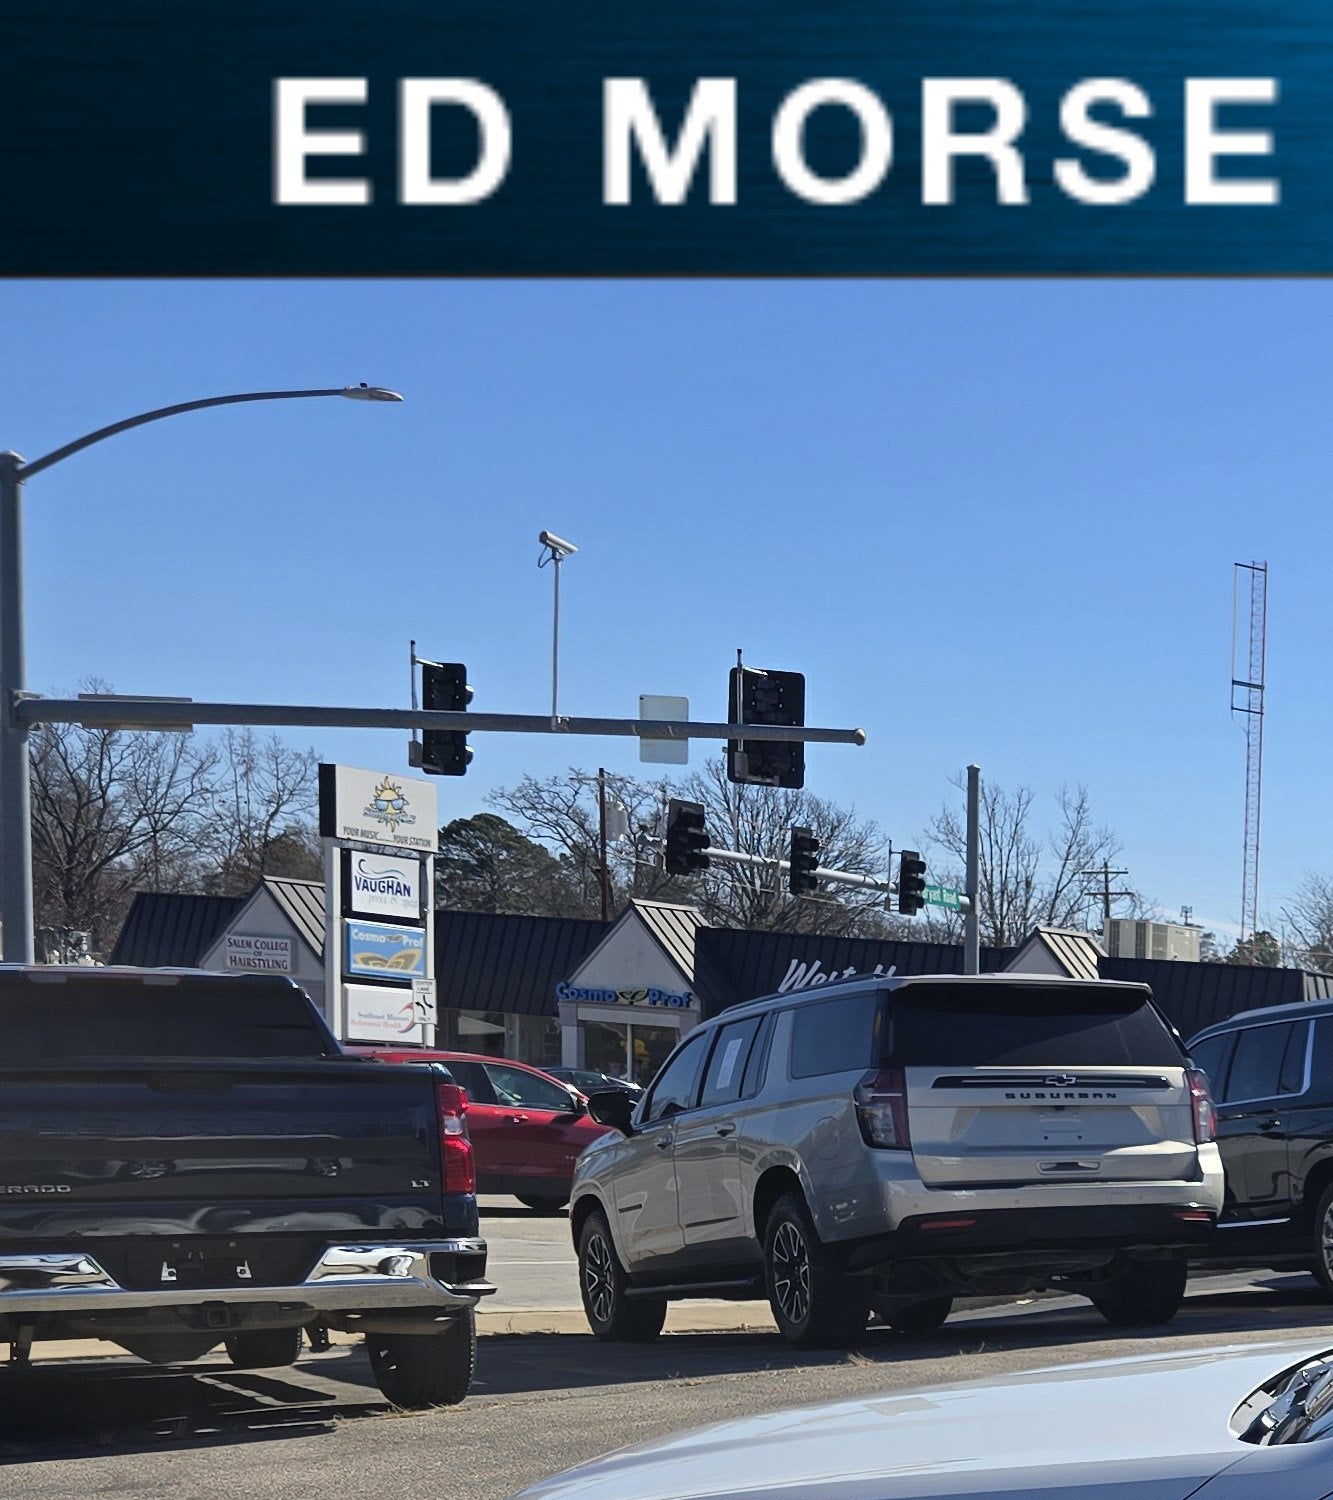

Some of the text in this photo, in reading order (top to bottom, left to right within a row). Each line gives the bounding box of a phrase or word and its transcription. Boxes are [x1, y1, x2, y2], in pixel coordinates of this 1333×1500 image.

[354, 875, 412, 897] VAUGHAN
[227, 937, 289, 951] SALEM COLLEGE
[352, 928, 424, 948] Cosmo Prof
[229, 955, 288, 970] HAIRSTYLING
[555, 980, 693, 1008] Cosmo Prof
[1005, 1092, 1117, 1100] SUBURBAN
[411, 1179, 431, 1188] LT
